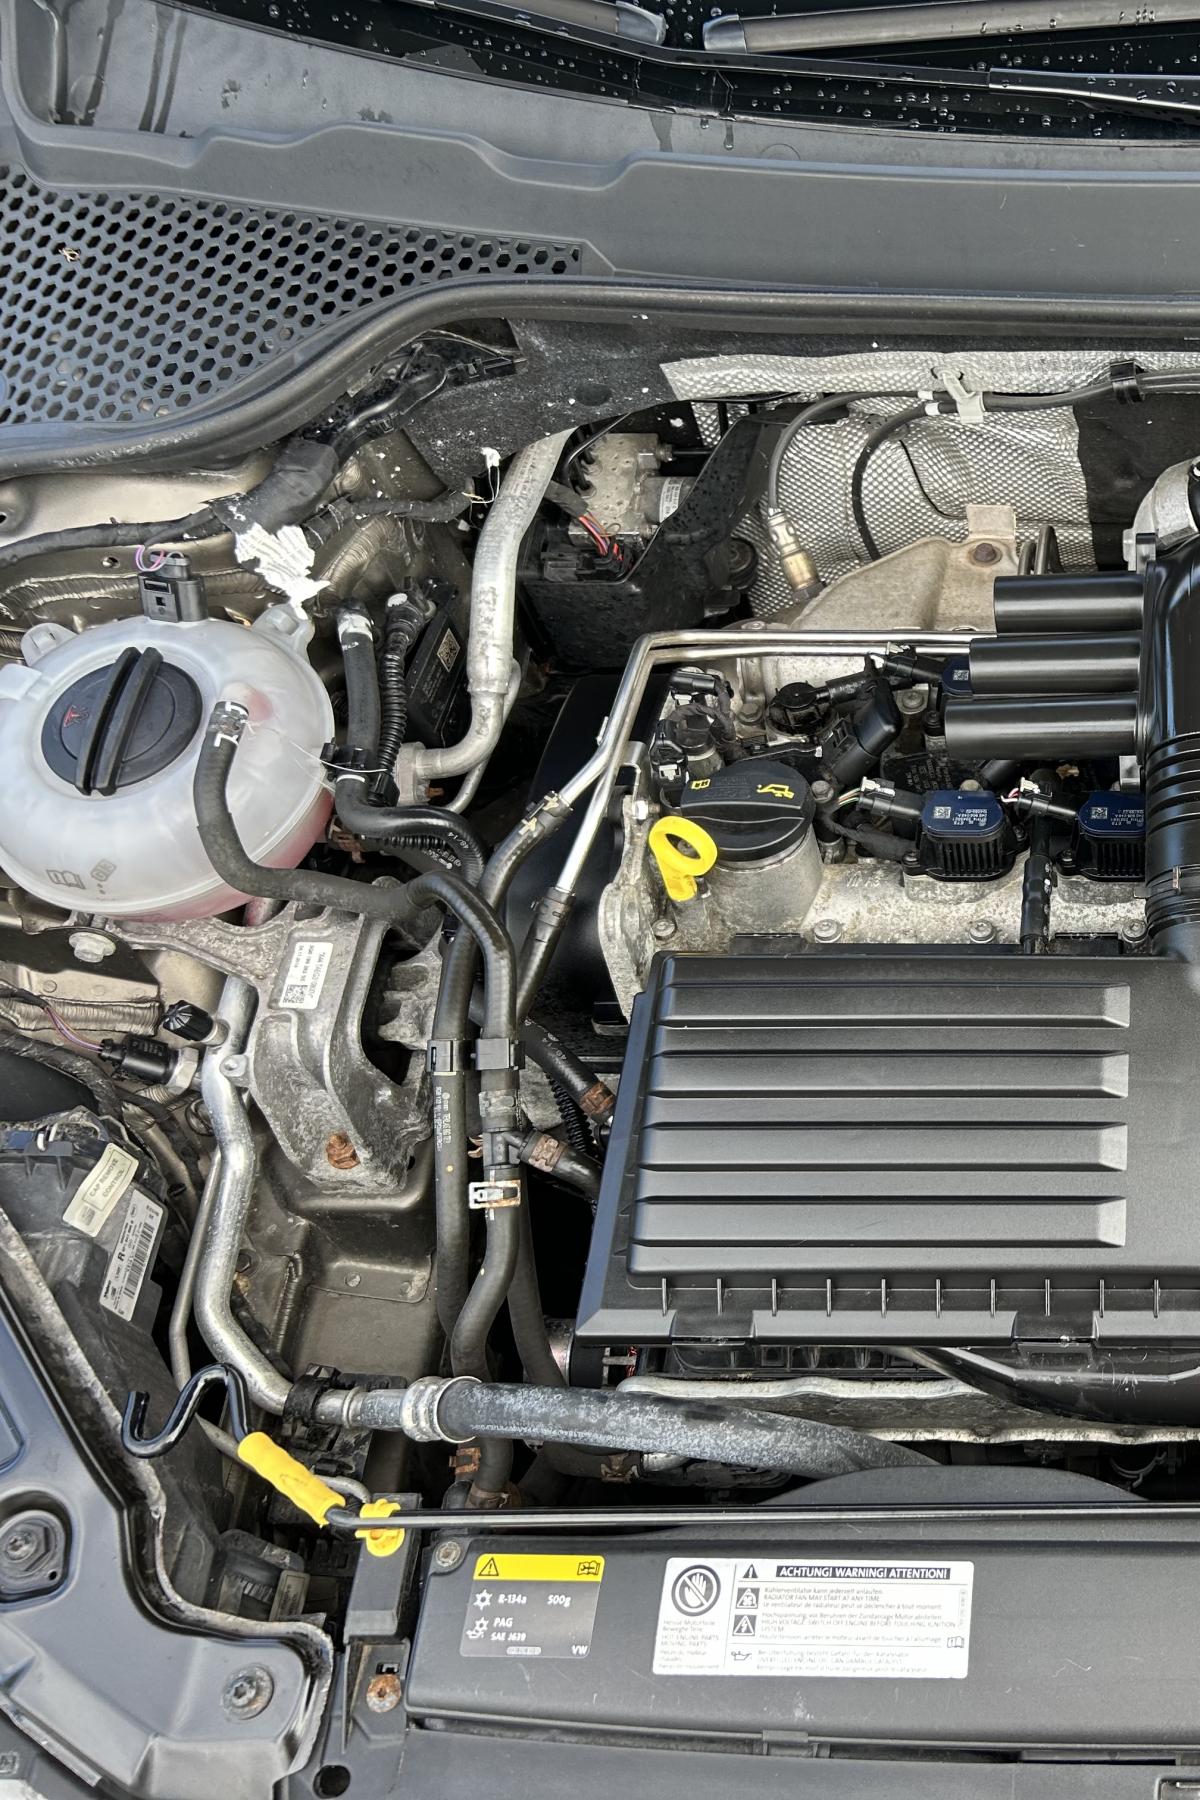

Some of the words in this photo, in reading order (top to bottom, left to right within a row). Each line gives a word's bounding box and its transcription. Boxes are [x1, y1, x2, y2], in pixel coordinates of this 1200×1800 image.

[89, 1183, 100, 1197] CAP
[98, 1158, 119, 1184] REMOVE
[102, 1169, 124, 1197] CONTROL
[117, 1252, 125, 1261] R
[780, 1567, 833, 1577] ACHTUNG!
[835, 1568, 888, 1578] WARNING!
[889, 1568, 947, 1579] ATTENTION!
[498, 1594, 527, 1604] R-134a
[547, 1594, 571, 1607] 500g
[493, 1617, 513, 1627] PAG
[491, 1632, 505, 1641] SAE
[507, 1632, 527, 1641] J639
[571, 1645, 588, 1655] VW
